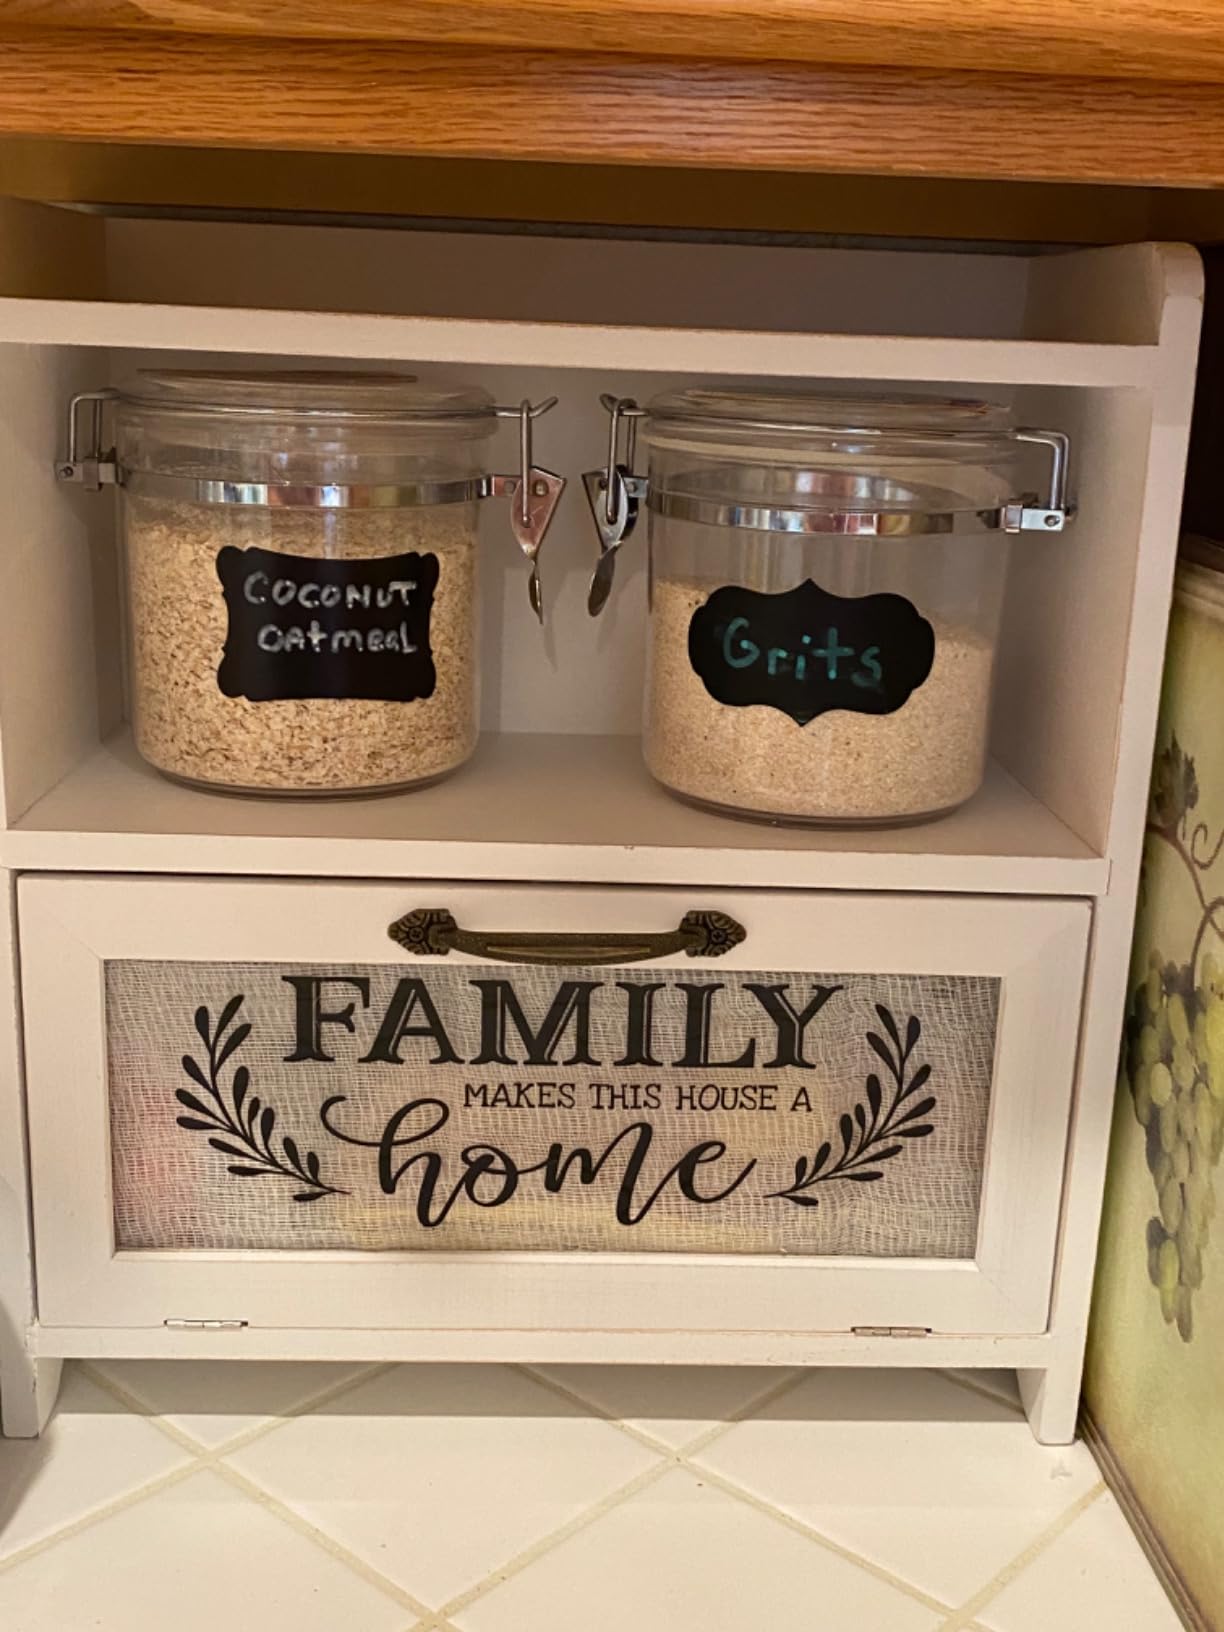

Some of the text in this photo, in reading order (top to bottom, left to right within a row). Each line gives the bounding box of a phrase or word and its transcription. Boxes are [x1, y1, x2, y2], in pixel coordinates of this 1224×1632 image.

[723, 616, 882, 687] Grits
[282, 974, 845, 1069] FAMILY
[463, 1082, 813, 1112] MAKES THIS HOUSE A
[319, 1095, 758, 1228] home
